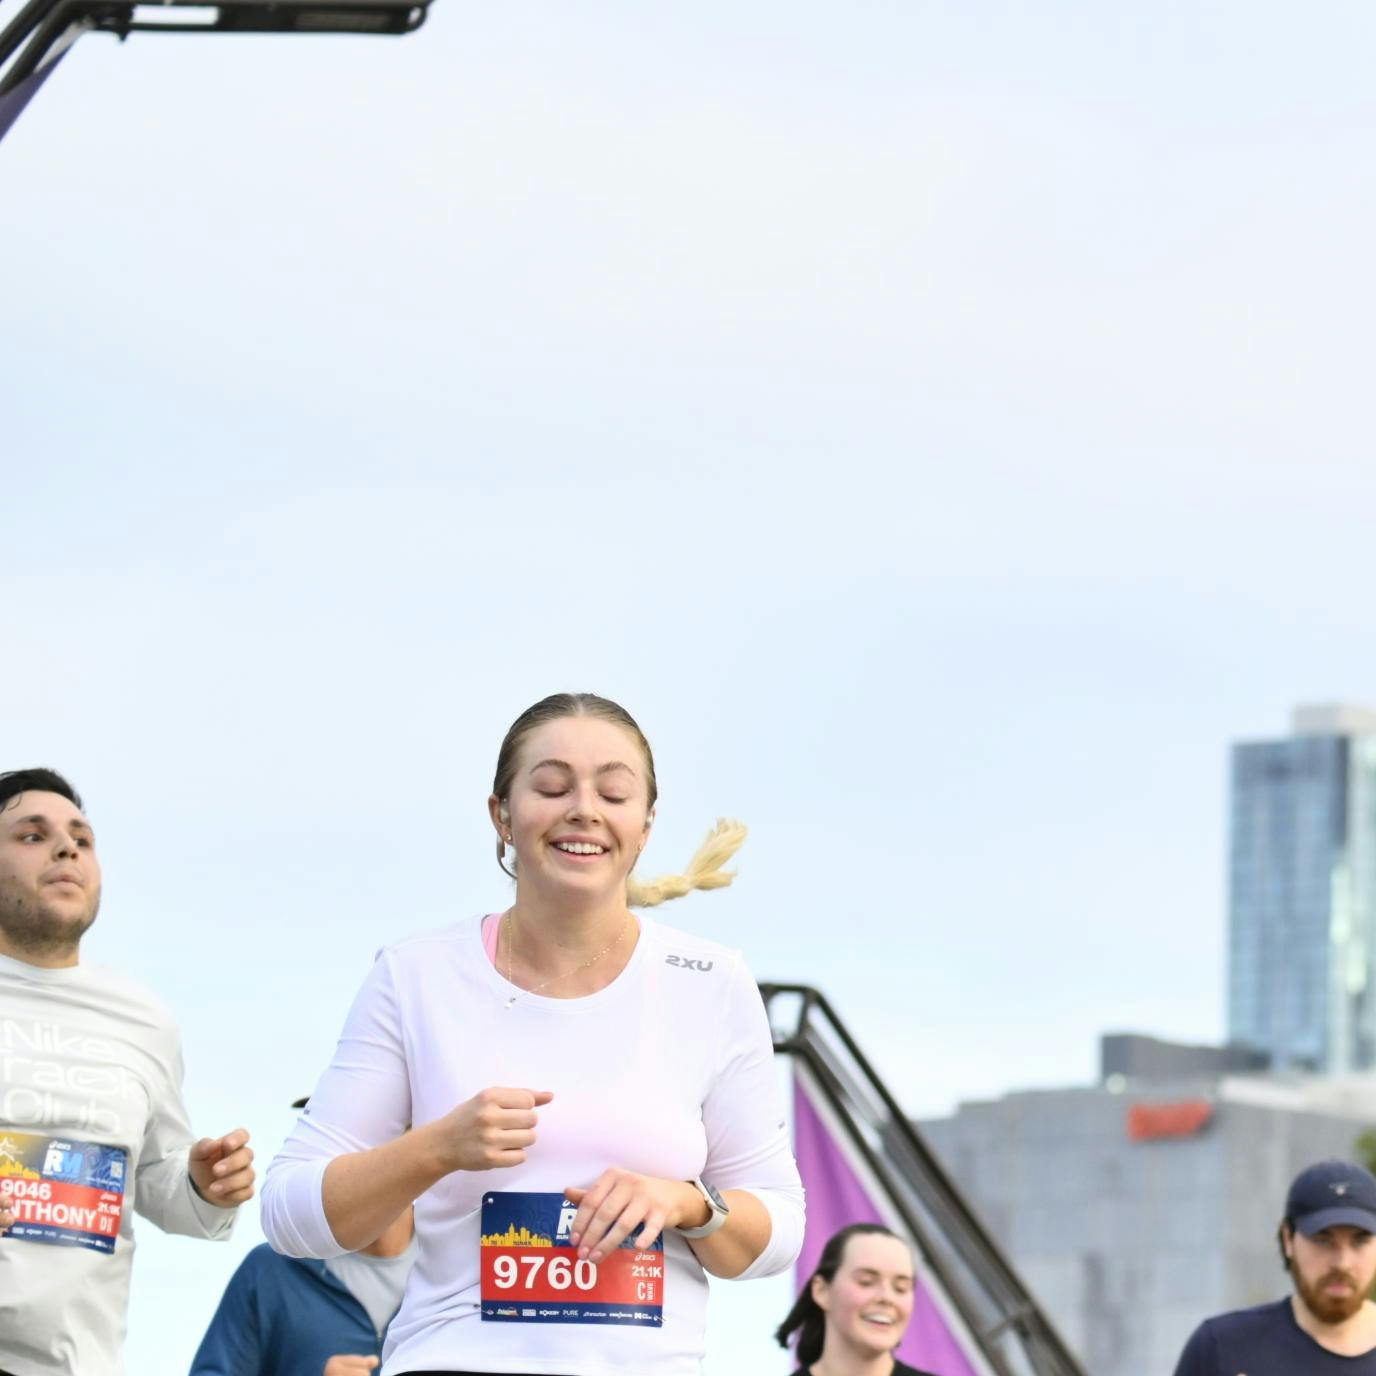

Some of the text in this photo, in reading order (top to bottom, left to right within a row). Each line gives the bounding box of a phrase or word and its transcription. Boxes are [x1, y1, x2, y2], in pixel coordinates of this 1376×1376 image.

[665, 955, 714, 972] 2XU
[3, 1019, 114, 1060] Nike
[0, 1048, 142, 1100] rack
[3, 1087, 121, 1137] Club
[1, 1179, 52, 1200] 9046
[11, 1199, 97, 1229] NTHONY
[493, 1256, 598, 1290] 9760
[631, 1265, 662, 1278] 21.1K
[637, 1281, 646, 1300] C
